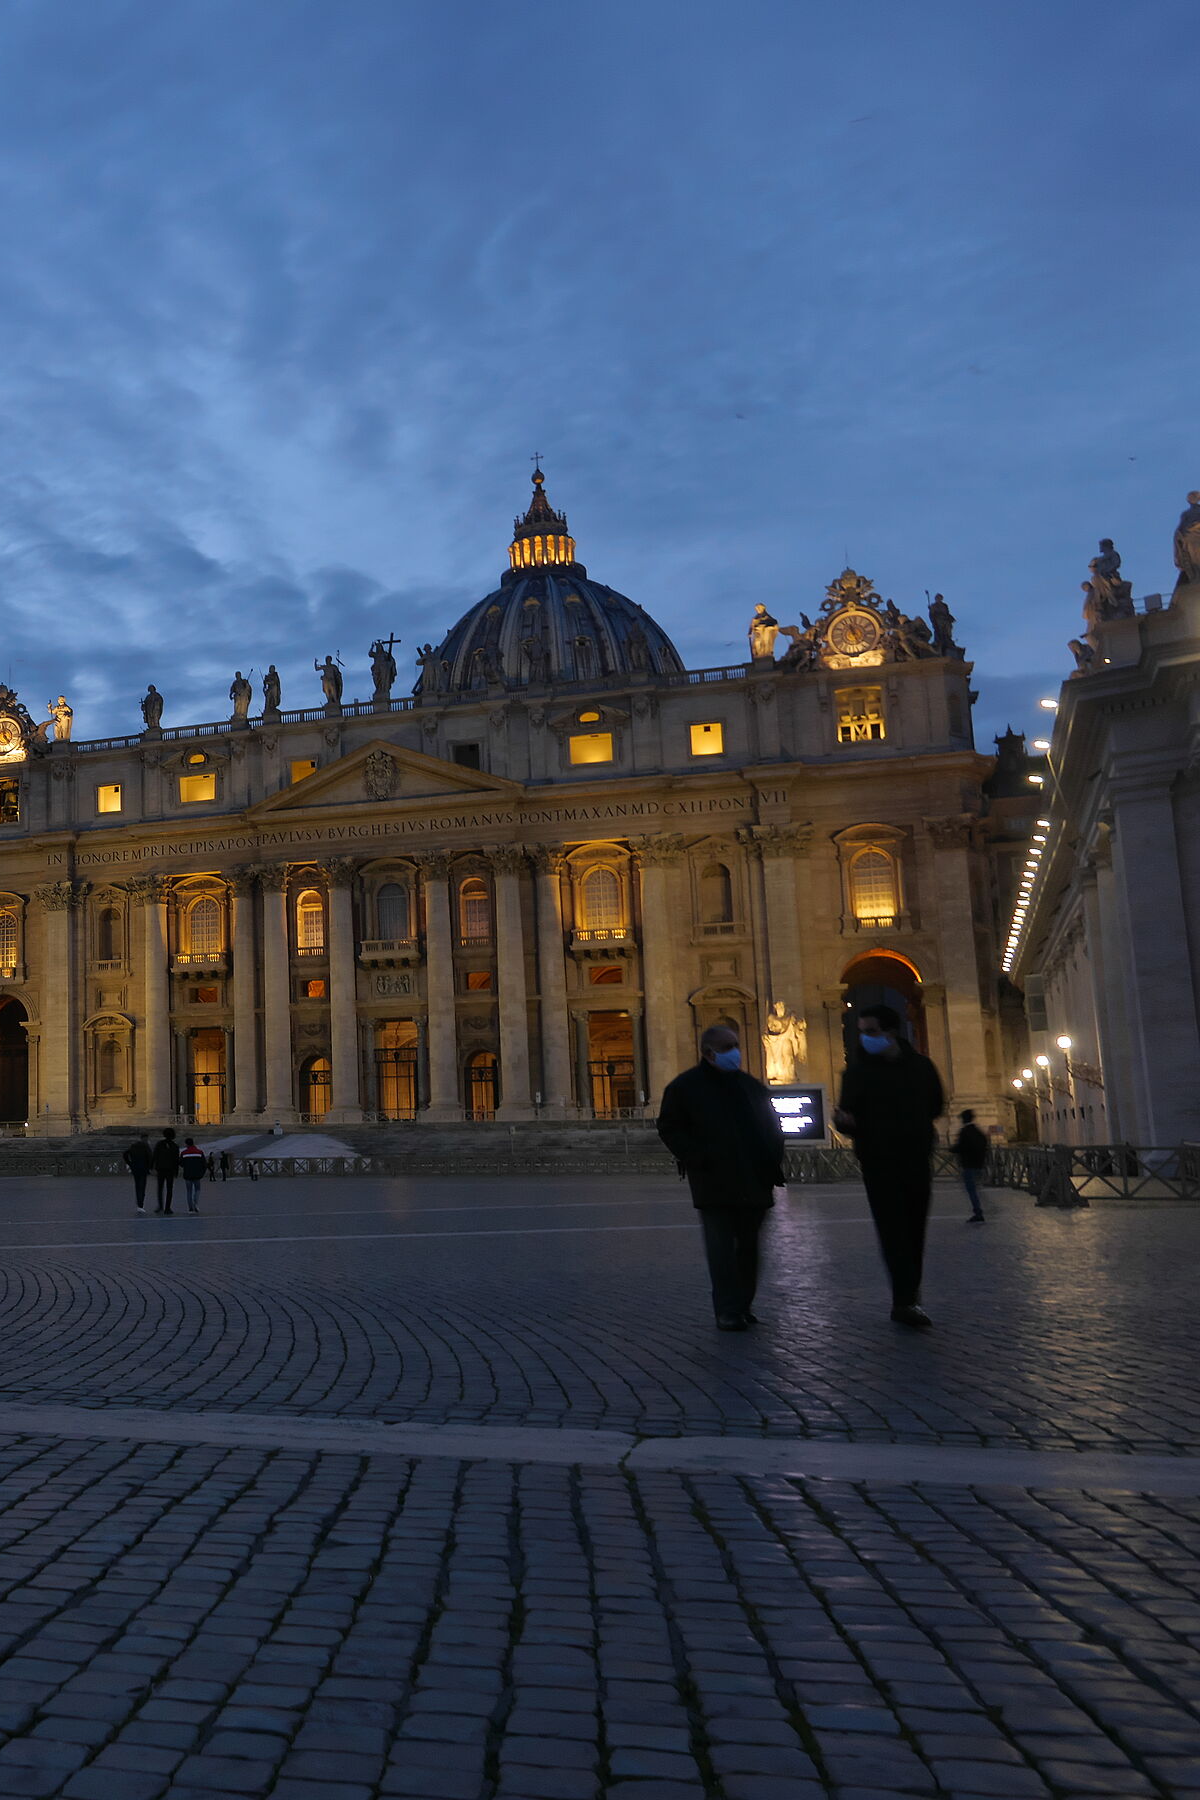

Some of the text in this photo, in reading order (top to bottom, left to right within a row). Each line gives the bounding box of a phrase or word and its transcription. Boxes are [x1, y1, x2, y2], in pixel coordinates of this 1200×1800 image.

[47, 854, 62, 865] IN
[72, 849, 142, 865] HONOREM
[143, 841, 214, 857] PRINCIPIS
[262, 830, 312, 845] PAVLVS
[328, 821, 425, 839] BVRGHESIVS
[430, 812, 513, 830] ROMANVS
[760, 790, 787, 803] VII
